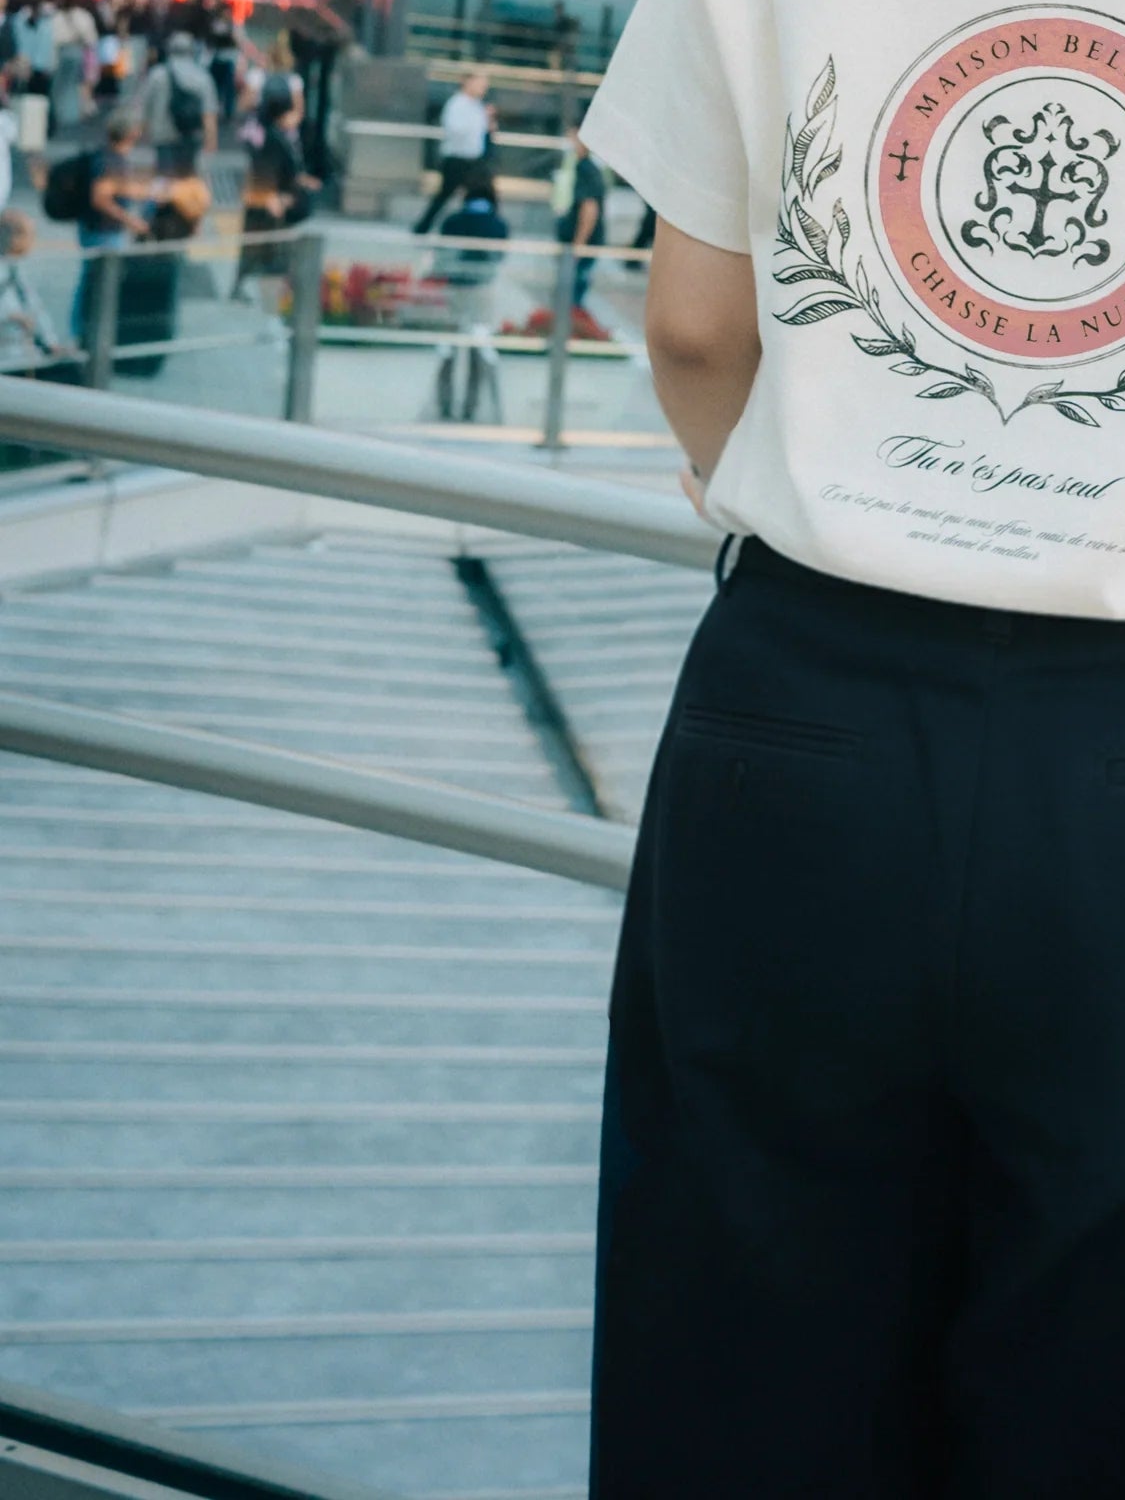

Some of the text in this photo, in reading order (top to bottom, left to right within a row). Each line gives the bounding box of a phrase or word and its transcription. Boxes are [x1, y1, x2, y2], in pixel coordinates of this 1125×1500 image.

[914, 33, 1039, 118] MAISON
[910, 252, 1009, 336] CHASSE
[1026, 323, 1062, 343] LA
[877, 435, 965, 470] Tu
[972, 467, 1053, 493] pas
[864, 498, 895, 513] pas
[896, 501, 912, 514] la
